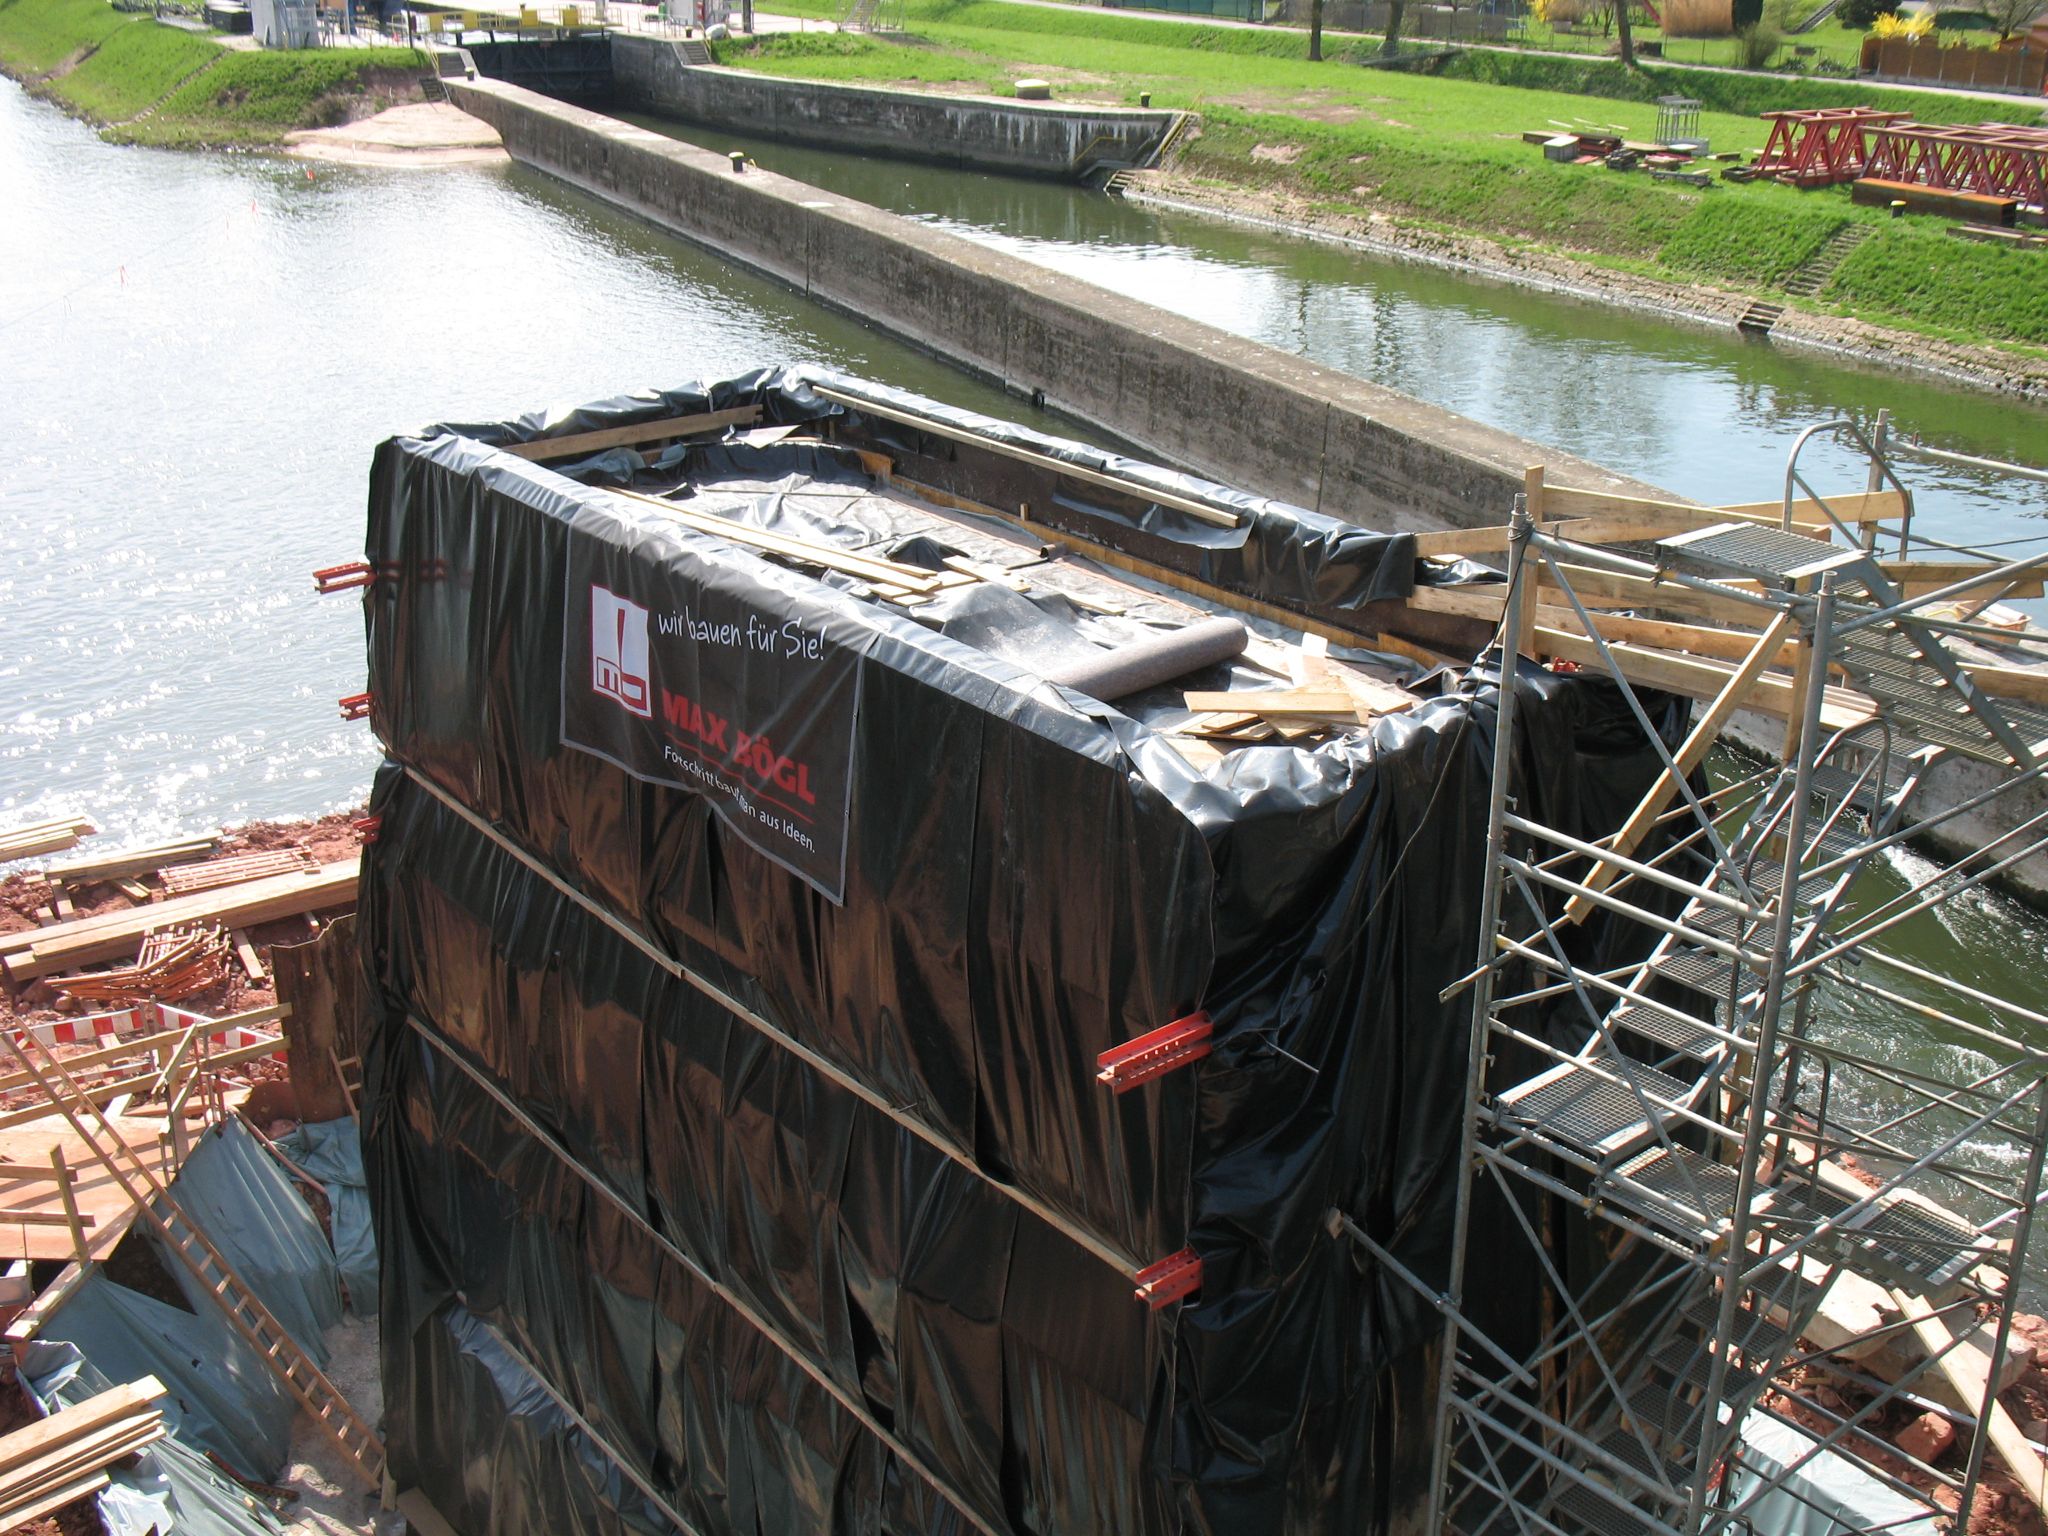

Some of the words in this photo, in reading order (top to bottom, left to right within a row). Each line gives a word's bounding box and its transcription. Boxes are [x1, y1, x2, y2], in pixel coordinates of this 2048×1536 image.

[658, 610, 684, 637] wir
[685, 605, 742, 647] bauen
[746, 614, 778, 653] für
[782, 616, 828, 661] Sie!
[662, 687, 729, 753] MAX
[733, 729, 817, 806] BÖGL
[664, 745, 714, 787] Fotschritt
[759, 810, 780, 831] aus
[783, 819, 816, 853] Ideen.
